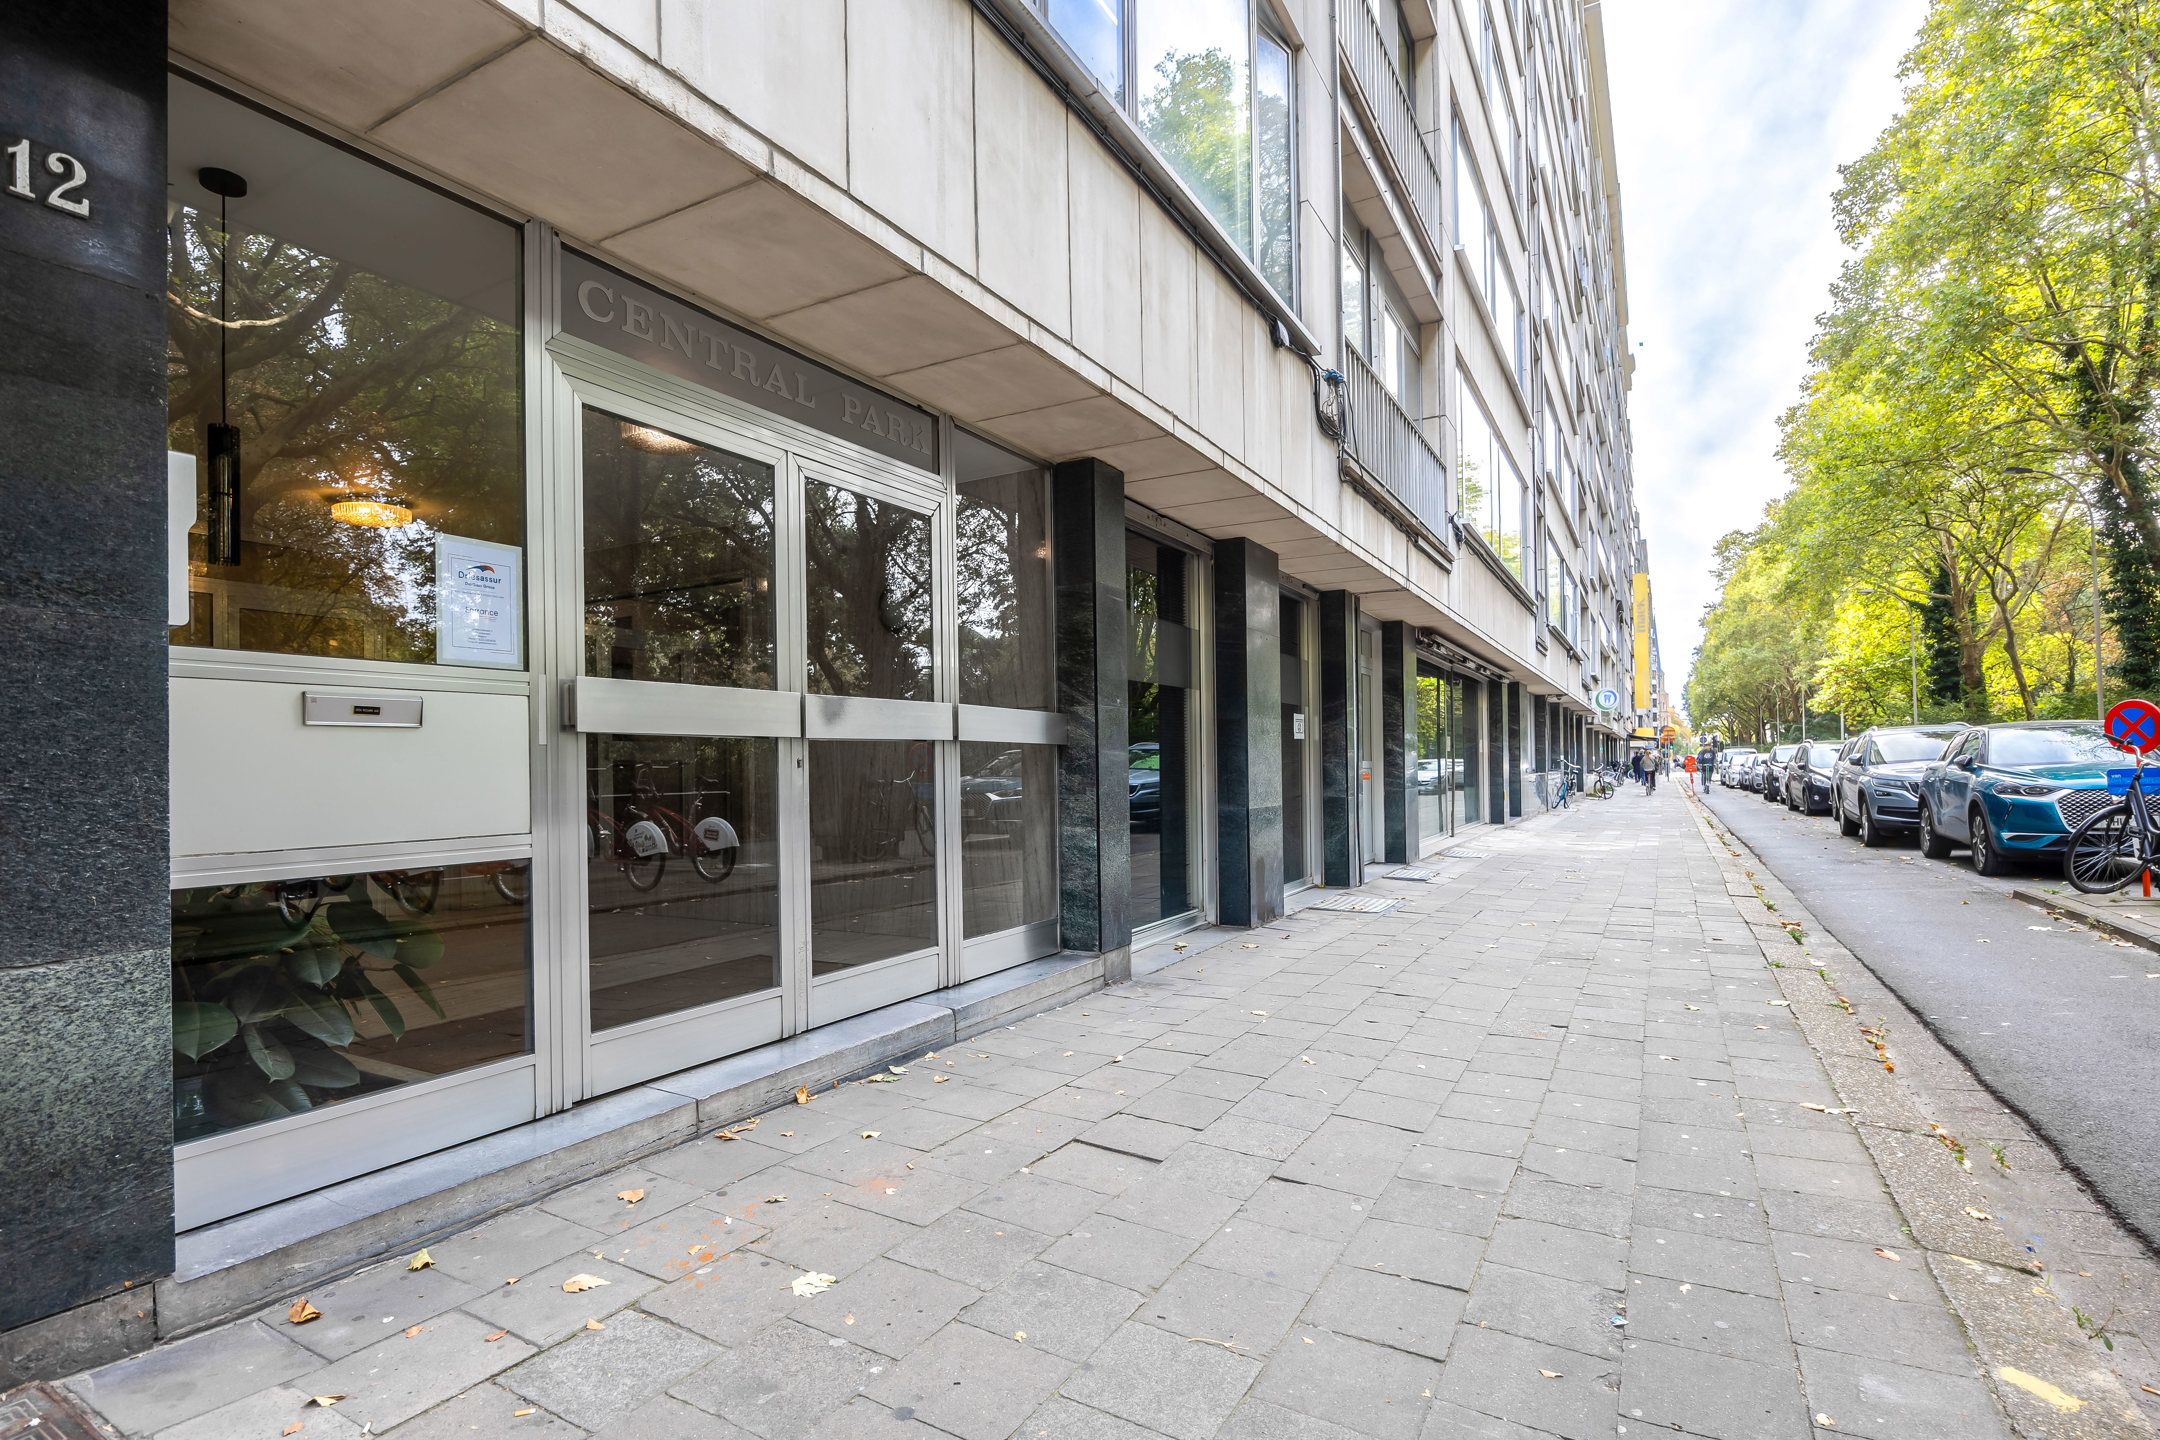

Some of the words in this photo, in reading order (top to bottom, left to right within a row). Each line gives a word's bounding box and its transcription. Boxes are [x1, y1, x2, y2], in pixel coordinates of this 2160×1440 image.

[7, 138, 90, 217] 12
[577, 279, 816, 409] CENTRAL
[839, 391, 931, 456] PARK
